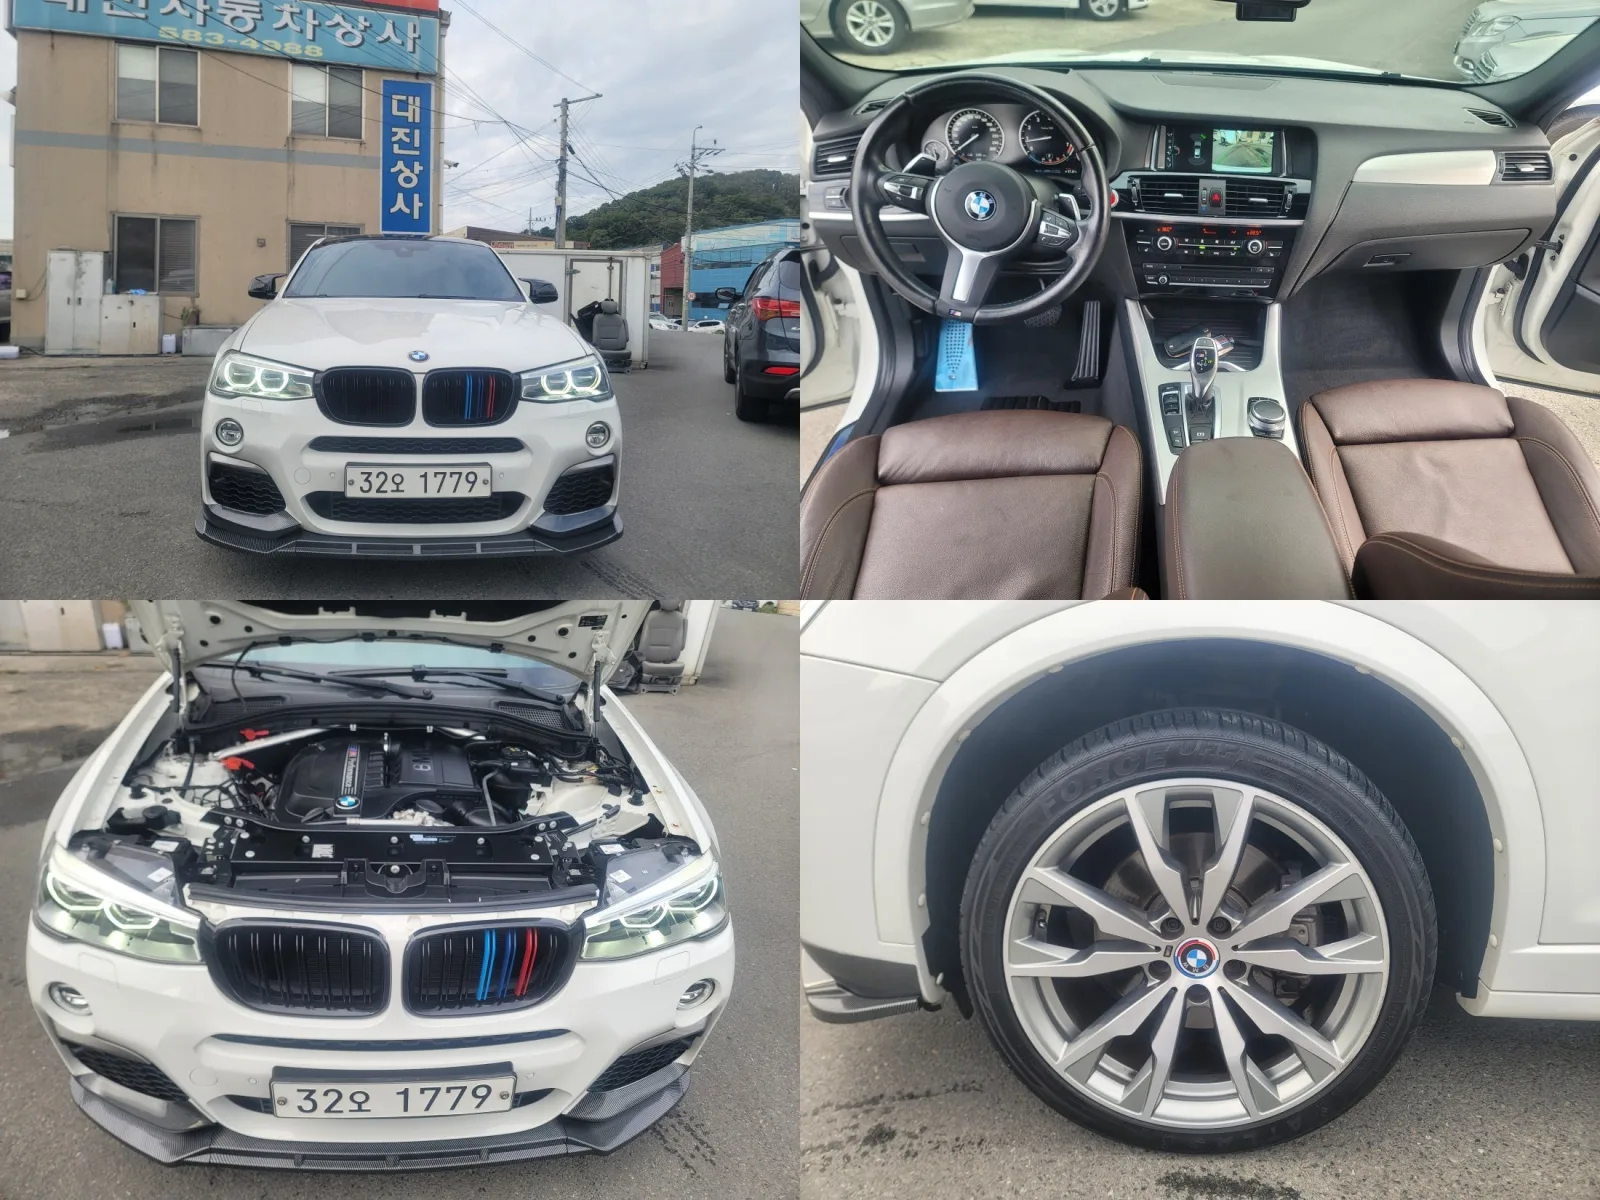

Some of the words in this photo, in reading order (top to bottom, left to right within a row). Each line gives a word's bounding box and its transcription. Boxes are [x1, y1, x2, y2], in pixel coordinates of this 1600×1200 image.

[158, 26, 324, 57] 583-4988
[390, 94, 424, 220] 대진상사
[359, 471, 405, 493] 32오
[419, 471, 478, 493] 1779
[1043, 746, 1169, 820] FORCE
[296, 1088, 372, 1114] 32오
[395, 1083, 493, 1113] 1779
